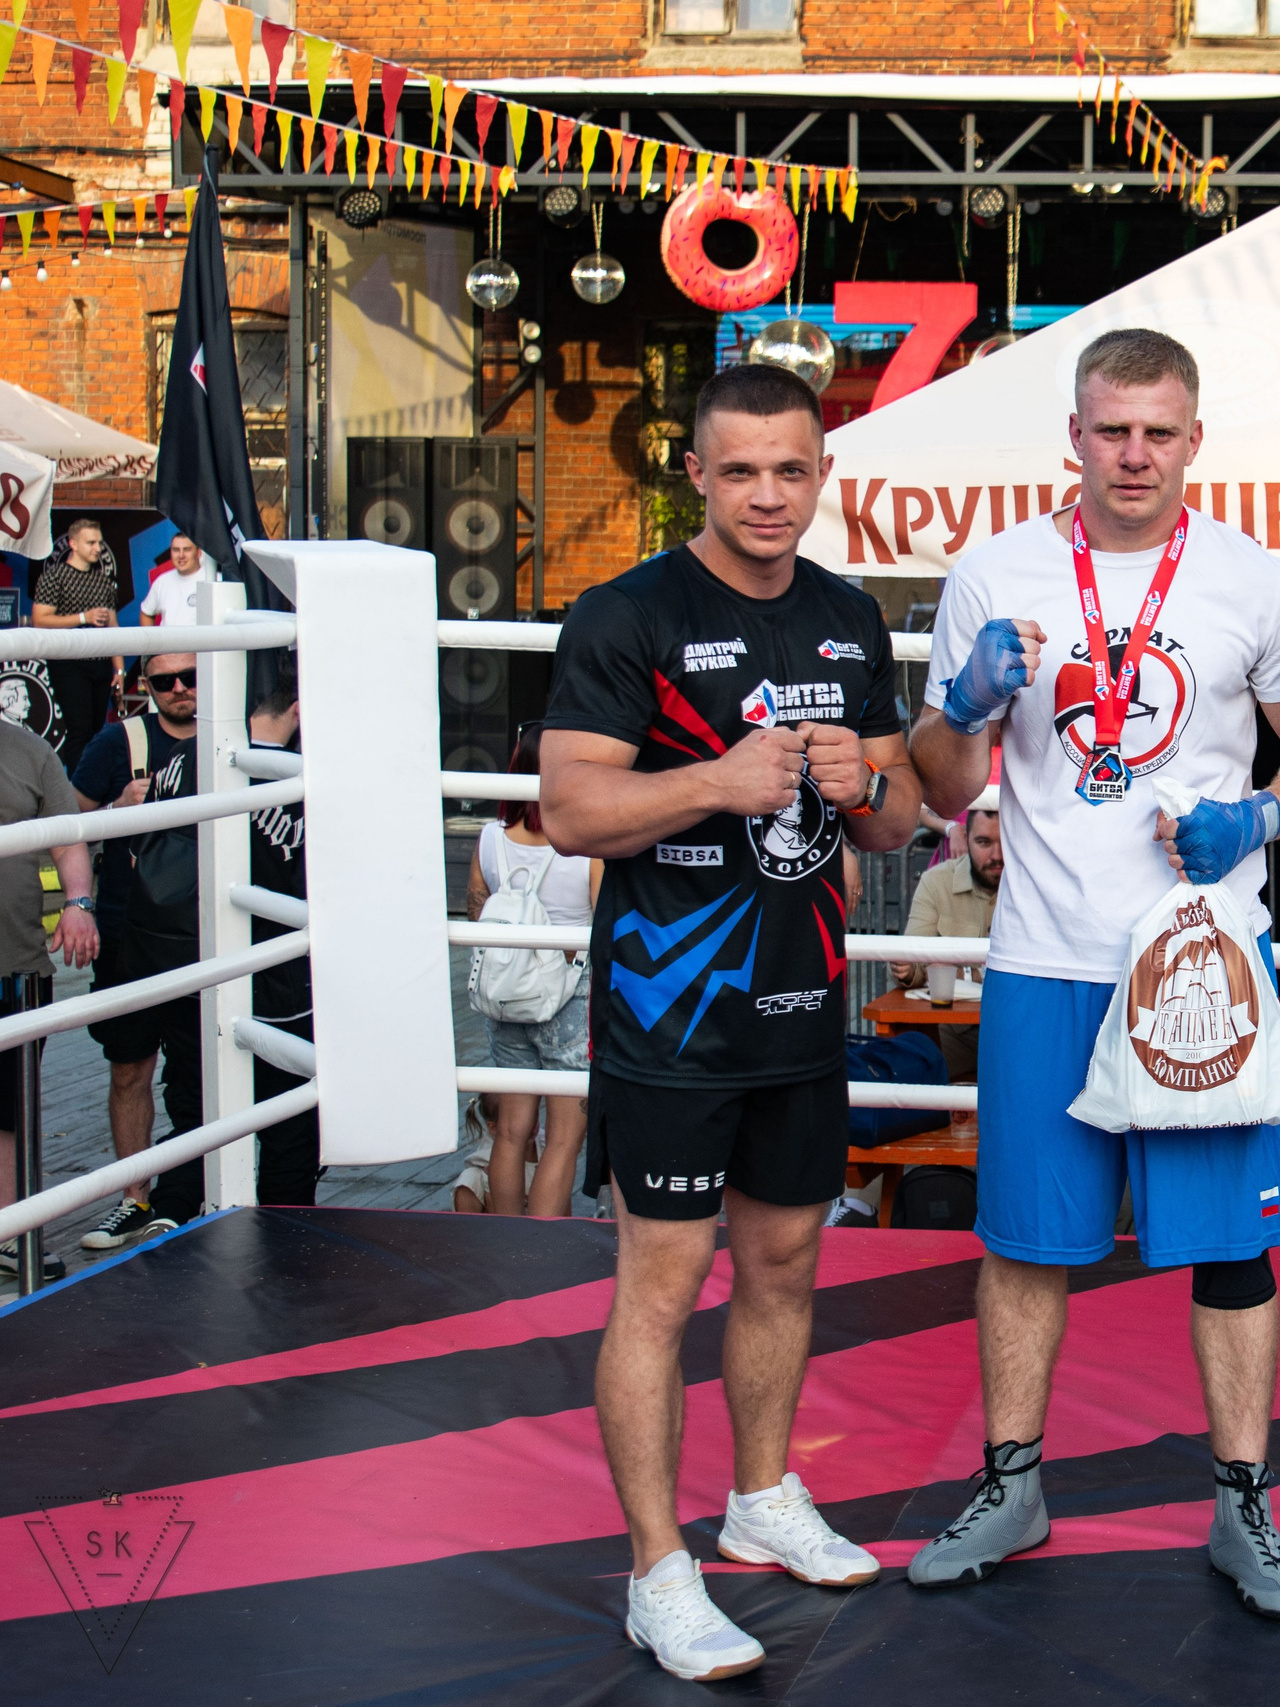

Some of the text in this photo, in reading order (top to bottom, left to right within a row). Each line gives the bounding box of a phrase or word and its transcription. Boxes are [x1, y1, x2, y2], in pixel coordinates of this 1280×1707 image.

[684, 637, 748, 659] ДМИТРИЙ
[1071, 626, 1185, 662] СРМАТ
[684, 654, 738, 673] ЖУКОВ
[777, 682, 845, 707] БИТВА
[777, 706, 844, 722] БЩЕПИТОВ
[1089, 783, 1123, 794] БИТВА
[660, 847, 720, 863] SIBSA
[760, 849, 822, 875] 2010
